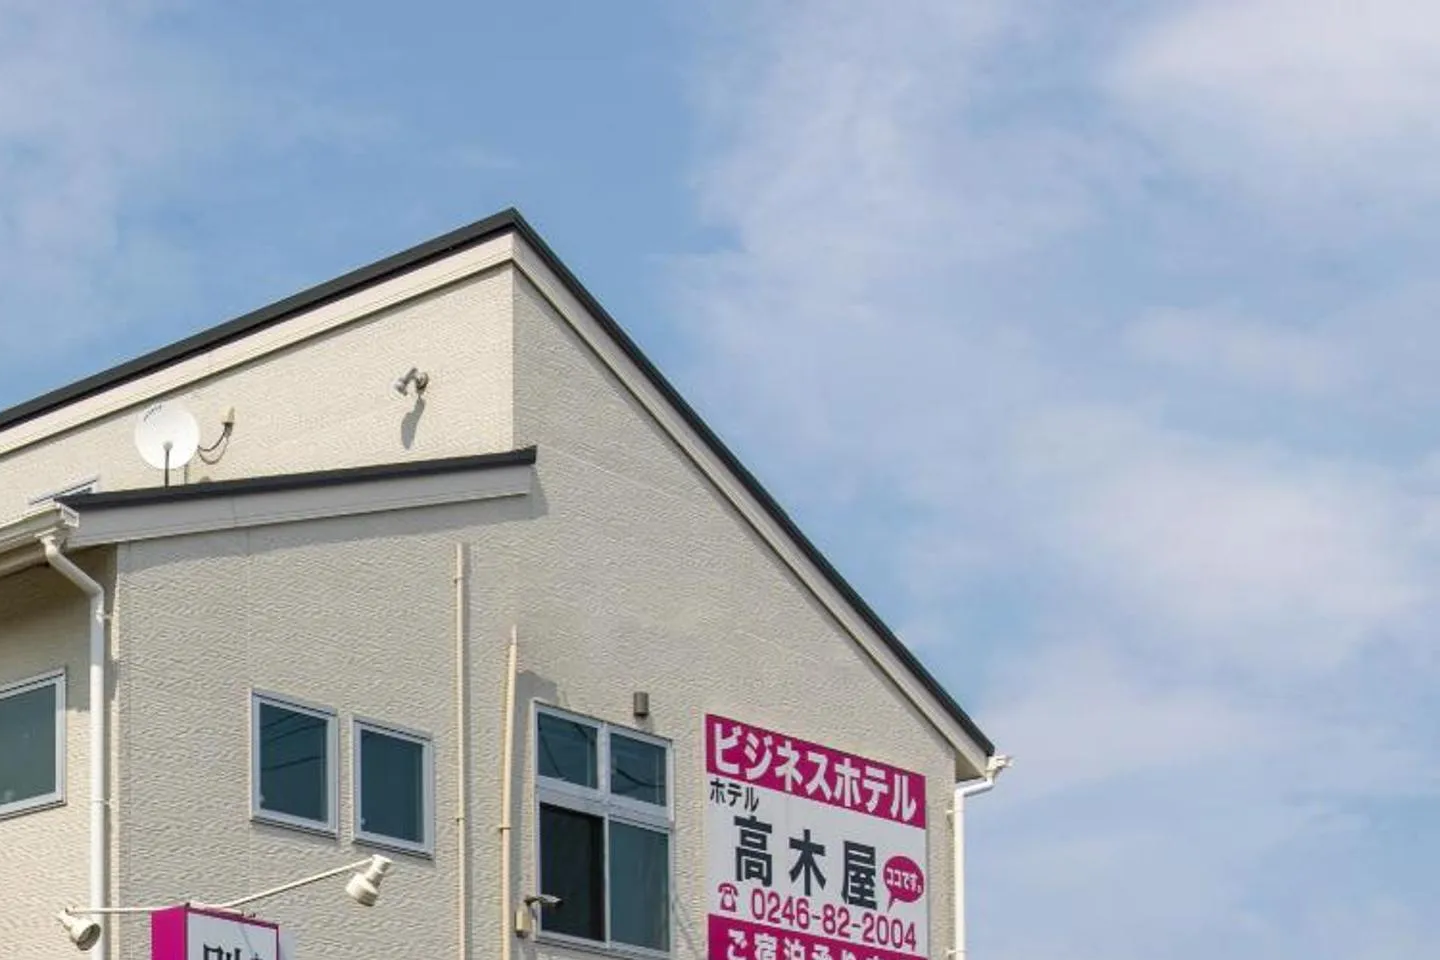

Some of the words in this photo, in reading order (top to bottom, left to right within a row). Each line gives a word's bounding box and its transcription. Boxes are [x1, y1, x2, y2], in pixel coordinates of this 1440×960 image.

[709, 777, 759, 812] ホテル
[714, 722, 917, 821] ビジネスホテル
[733, 815, 878, 911] 高木屋
[750, 888, 917, 950] 0246-82-2004
